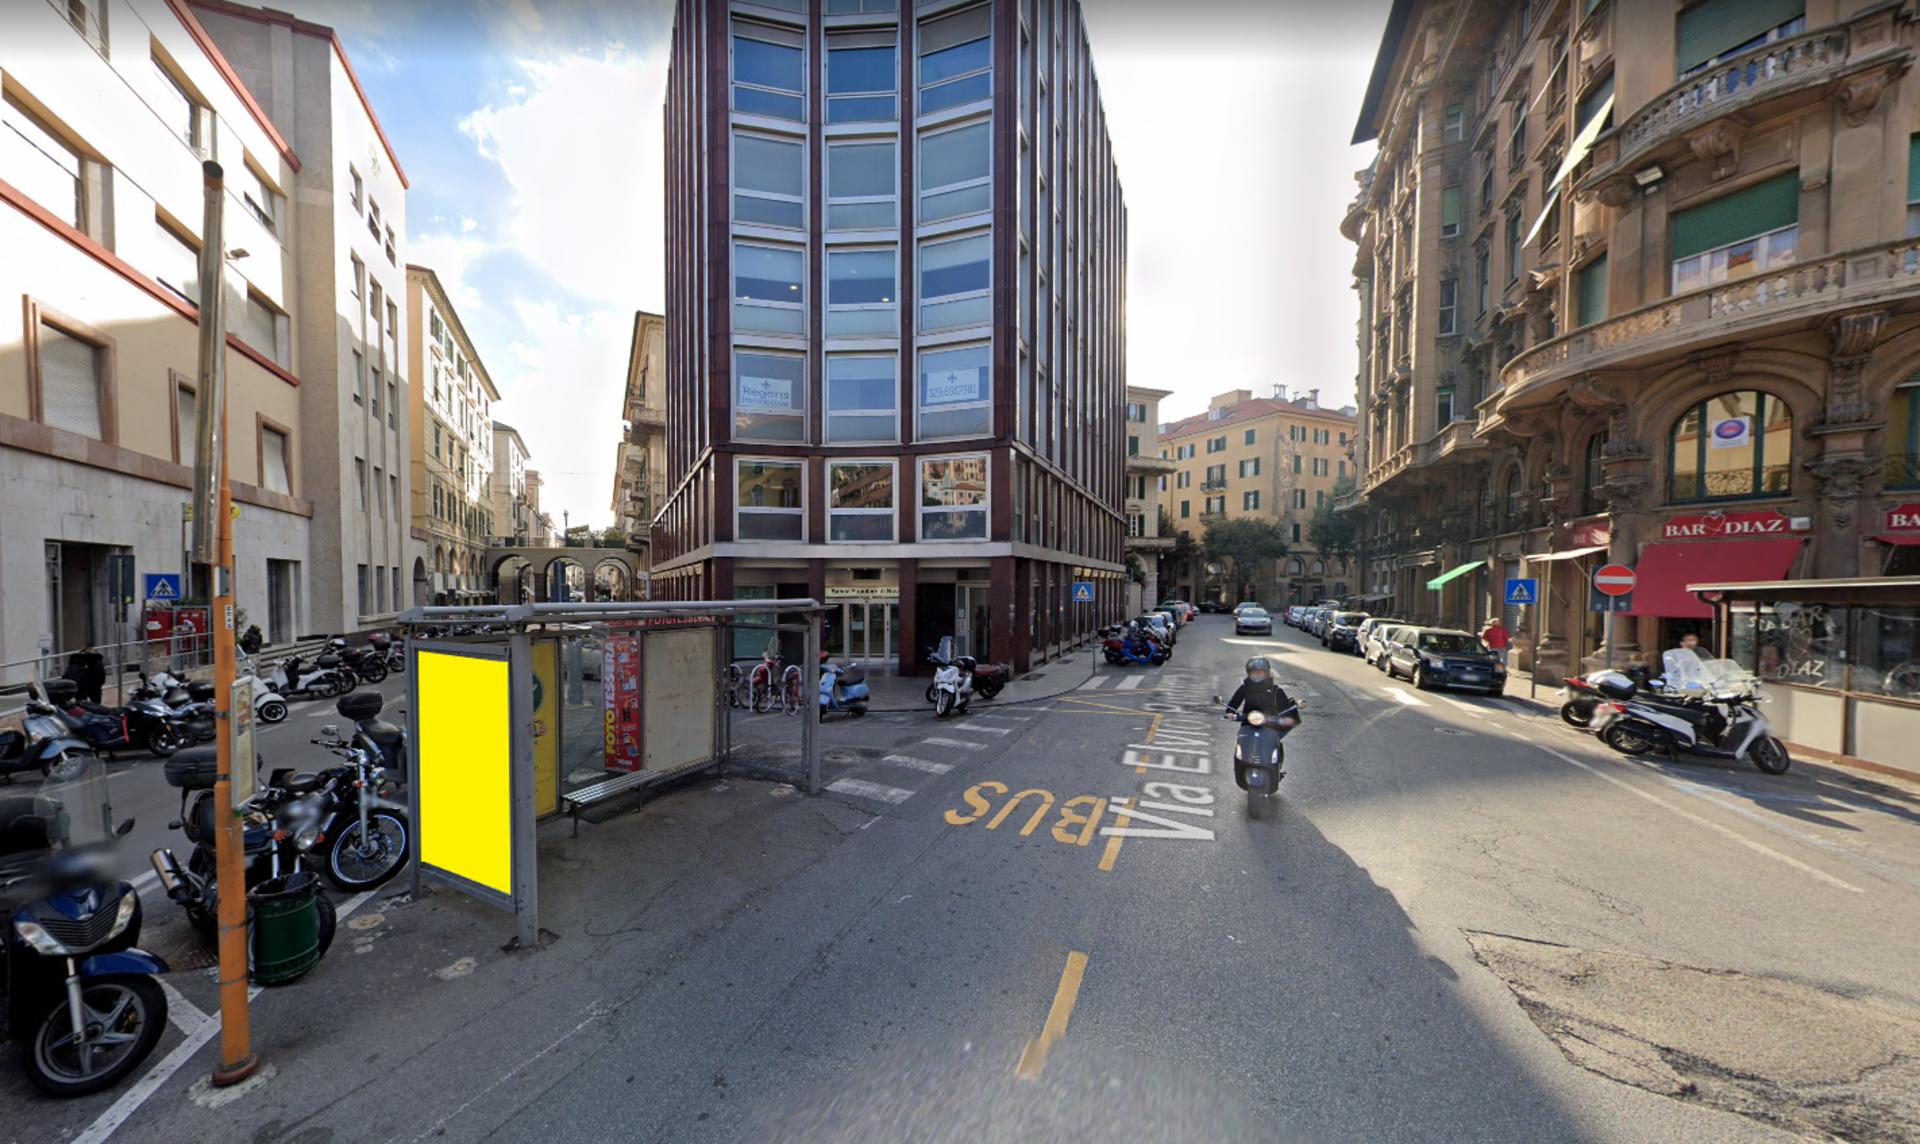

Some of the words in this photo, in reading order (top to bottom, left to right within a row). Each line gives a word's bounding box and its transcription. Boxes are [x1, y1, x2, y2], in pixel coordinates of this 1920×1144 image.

[1665, 523, 1706, 537] BAR
[1724, 519, 1784, 535] DIAZ
[943, 780, 1108, 847] BUS
